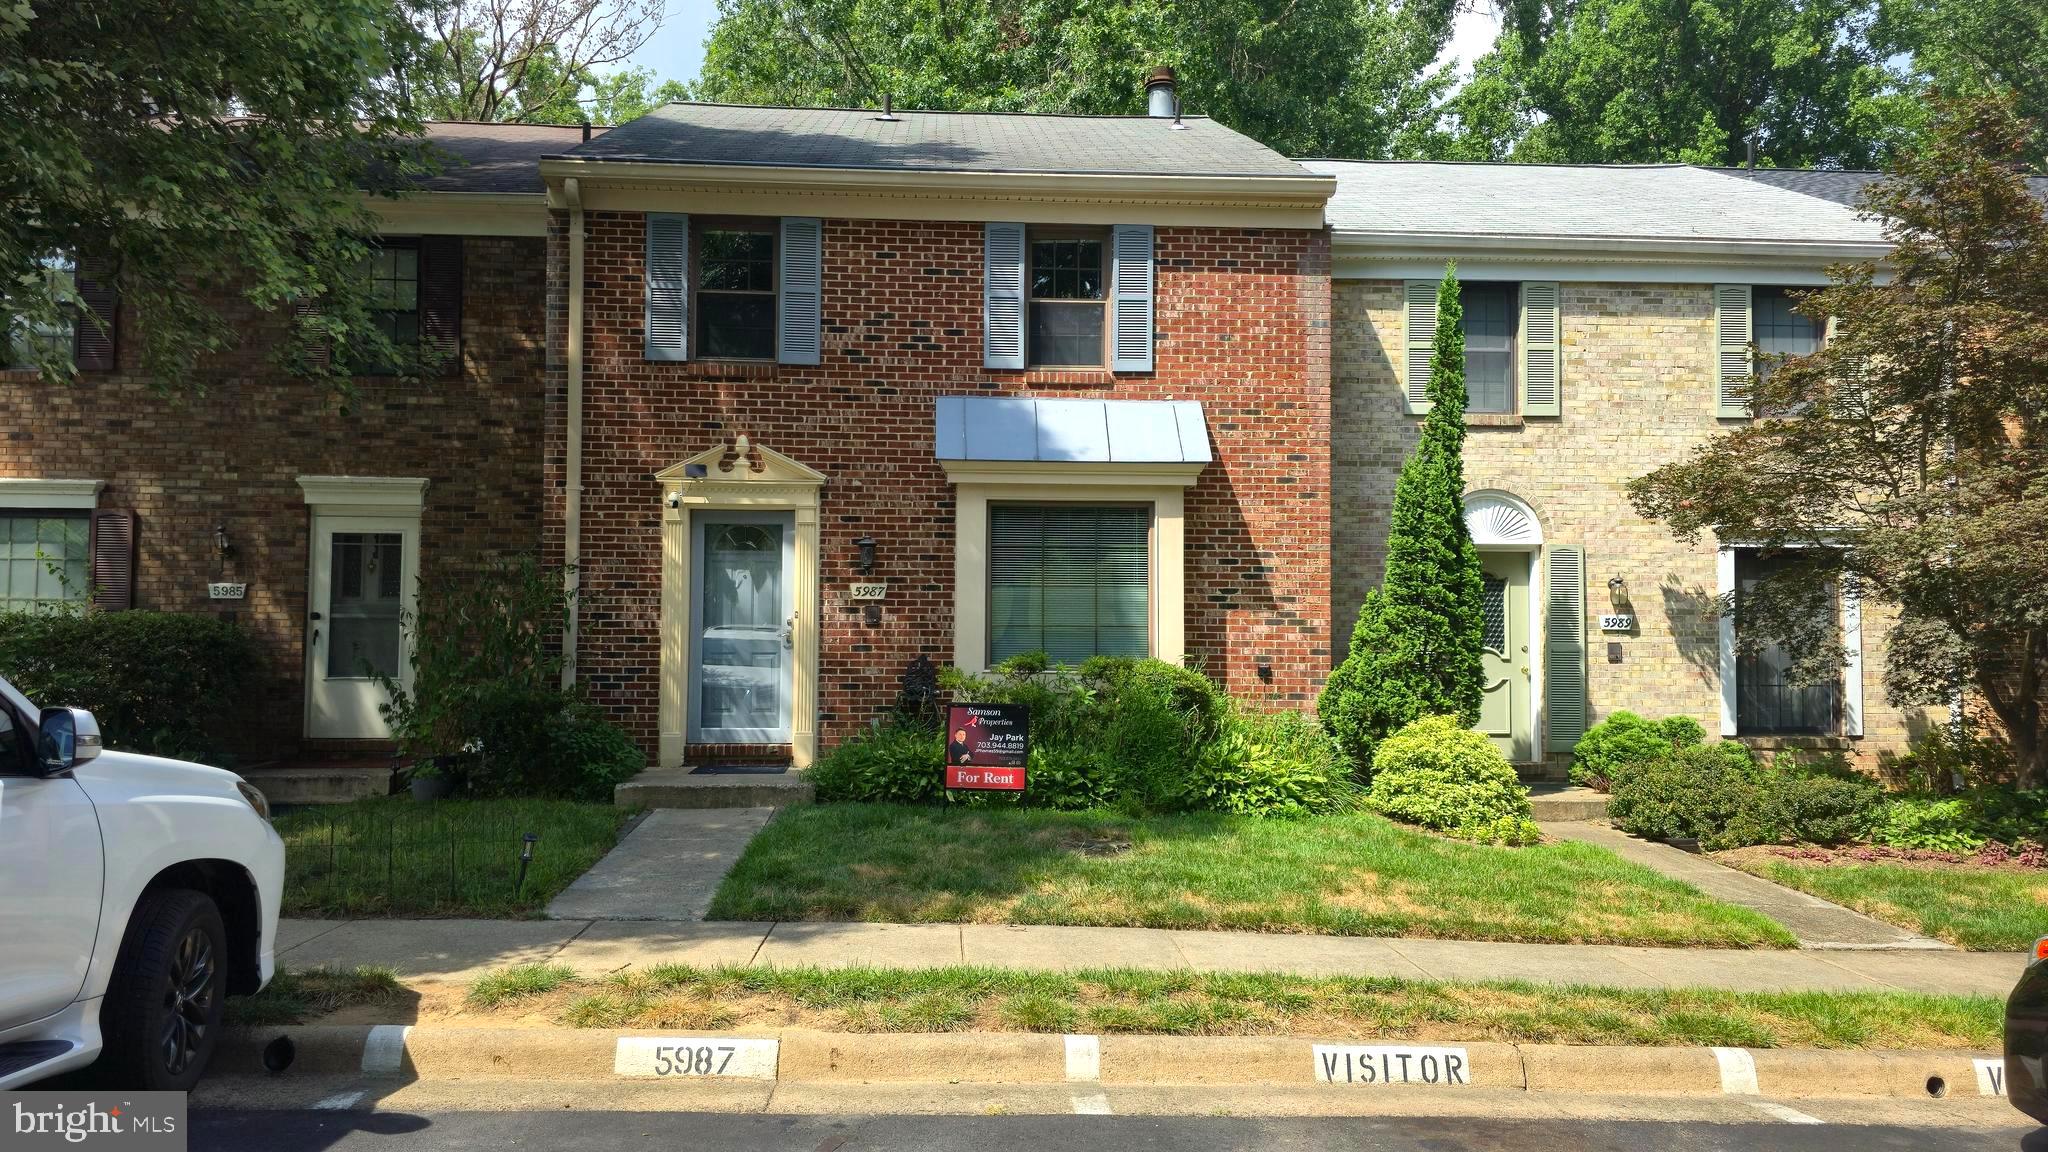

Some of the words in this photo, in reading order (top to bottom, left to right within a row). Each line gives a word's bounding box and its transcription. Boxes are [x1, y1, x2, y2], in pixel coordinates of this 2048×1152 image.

[213, 586, 243, 597] 5985
[853, 586, 886, 597] 5987
[1603, 617, 1632, 628] 5989
[967, 707, 1001, 716] Samson
[979, 718, 1013, 727] Properties
[990, 733, 1004, 742] Jay
[1005, 733, 1024, 741] Park
[977, 741, 1024, 750] 703.944.8819
[957, 771, 980, 783] For
[984, 772, 1014, 783] Rent
[655, 1046, 735, 1076] 5987
[1322, 1052, 1463, 1084] VISITOR
